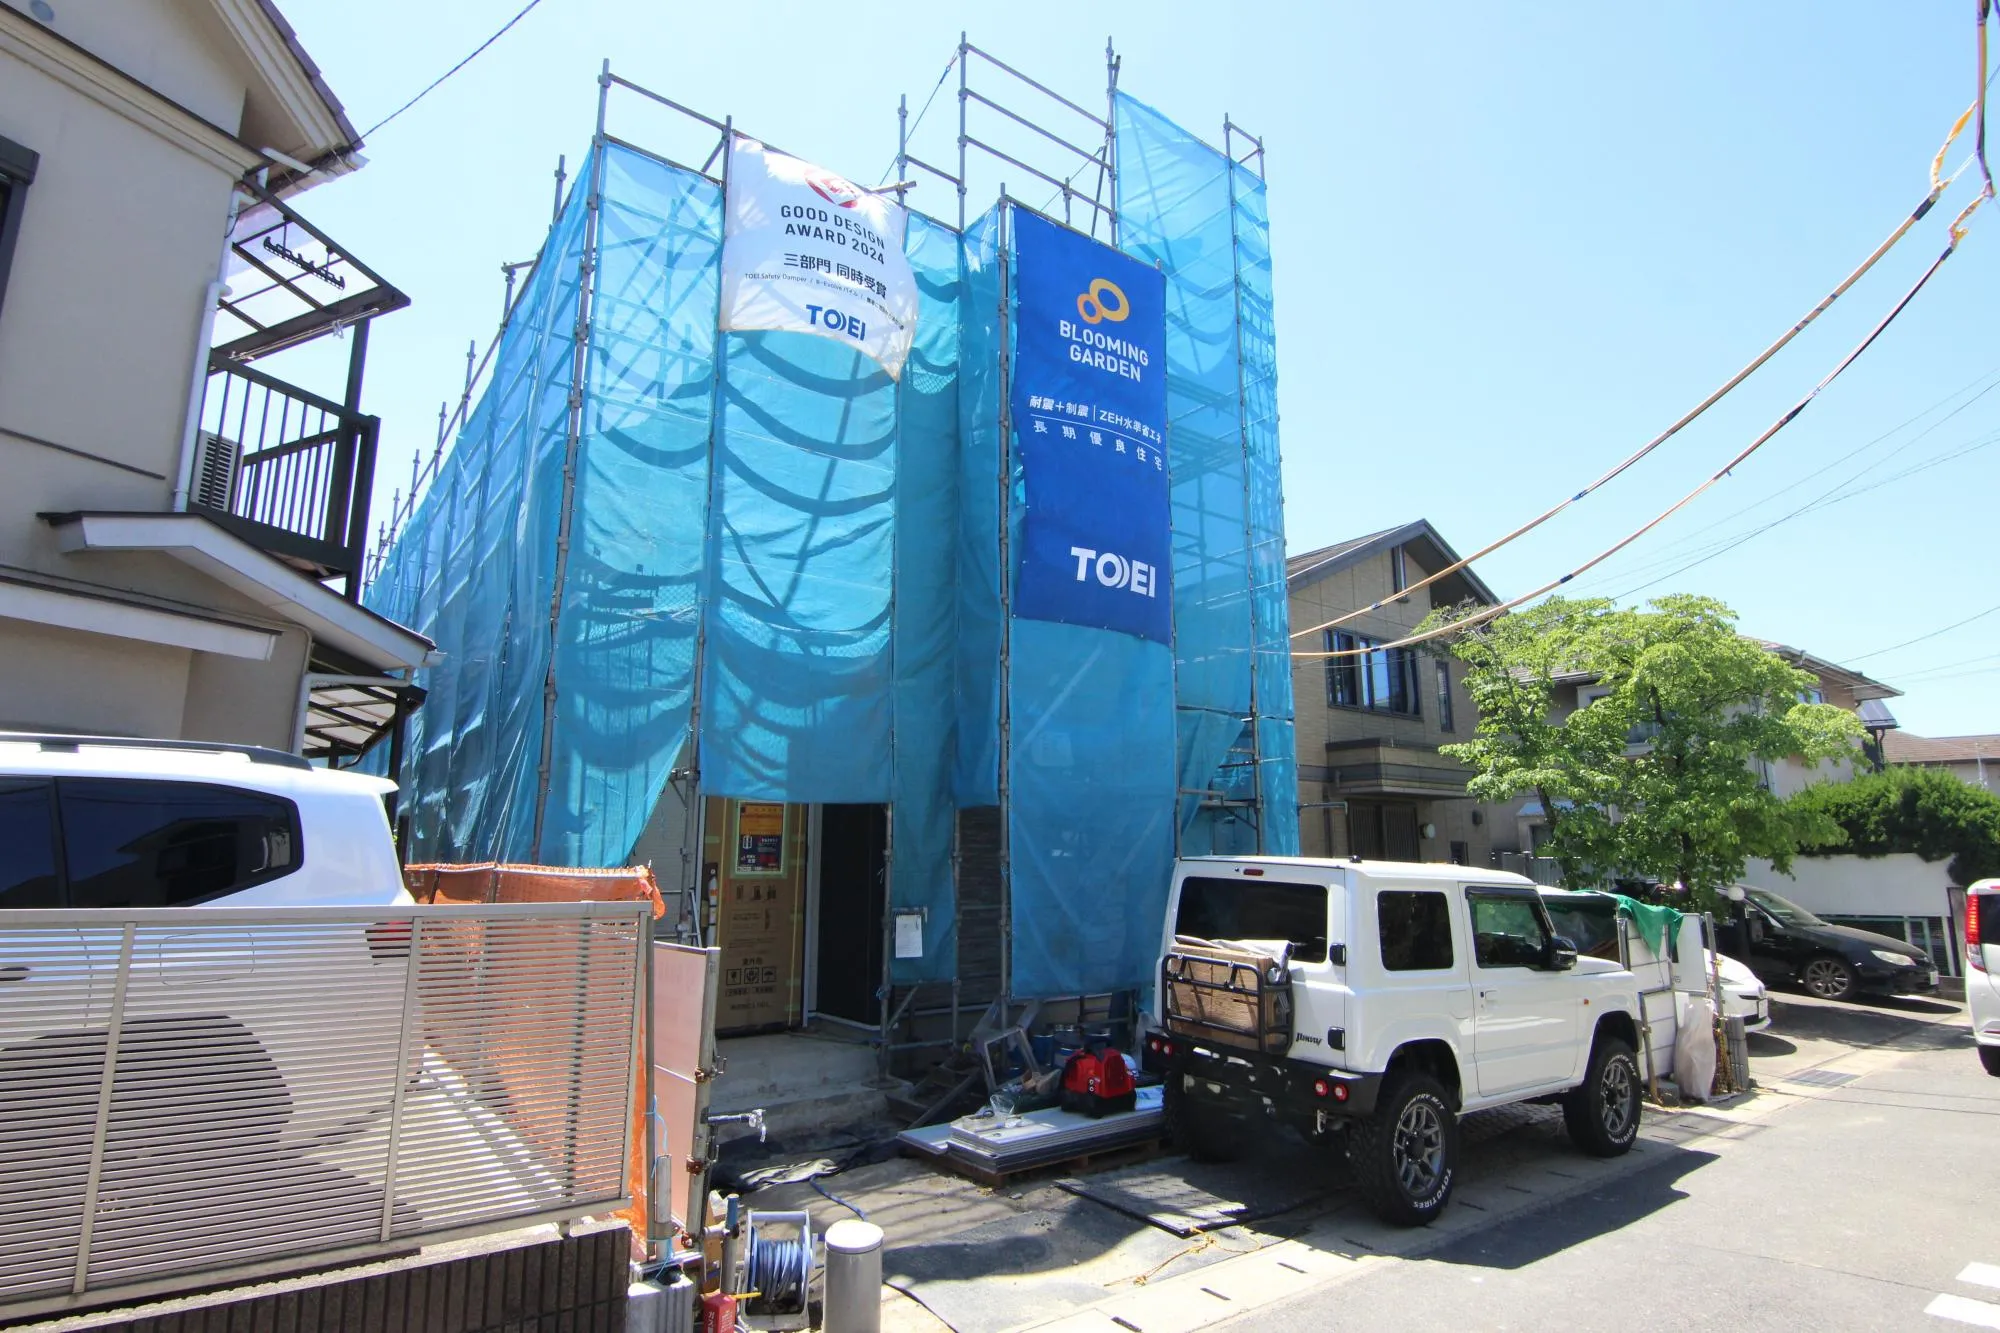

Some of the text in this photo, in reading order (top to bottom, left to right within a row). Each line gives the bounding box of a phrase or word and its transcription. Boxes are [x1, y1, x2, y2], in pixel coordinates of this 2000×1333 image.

[781, 205, 885, 249] GOOD DESIGN
[785, 223, 885, 265] AWARD 2024
[782, 273, 807, 282] Damper
[784, 253, 887, 300] 三部門 同時受賞
[806, 304, 866, 341] TOEI
[1059, 319, 1149, 367] BLOOMING
[1069, 344, 1141, 383] GARDEN
[1070, 546, 1156, 598] TOEI
